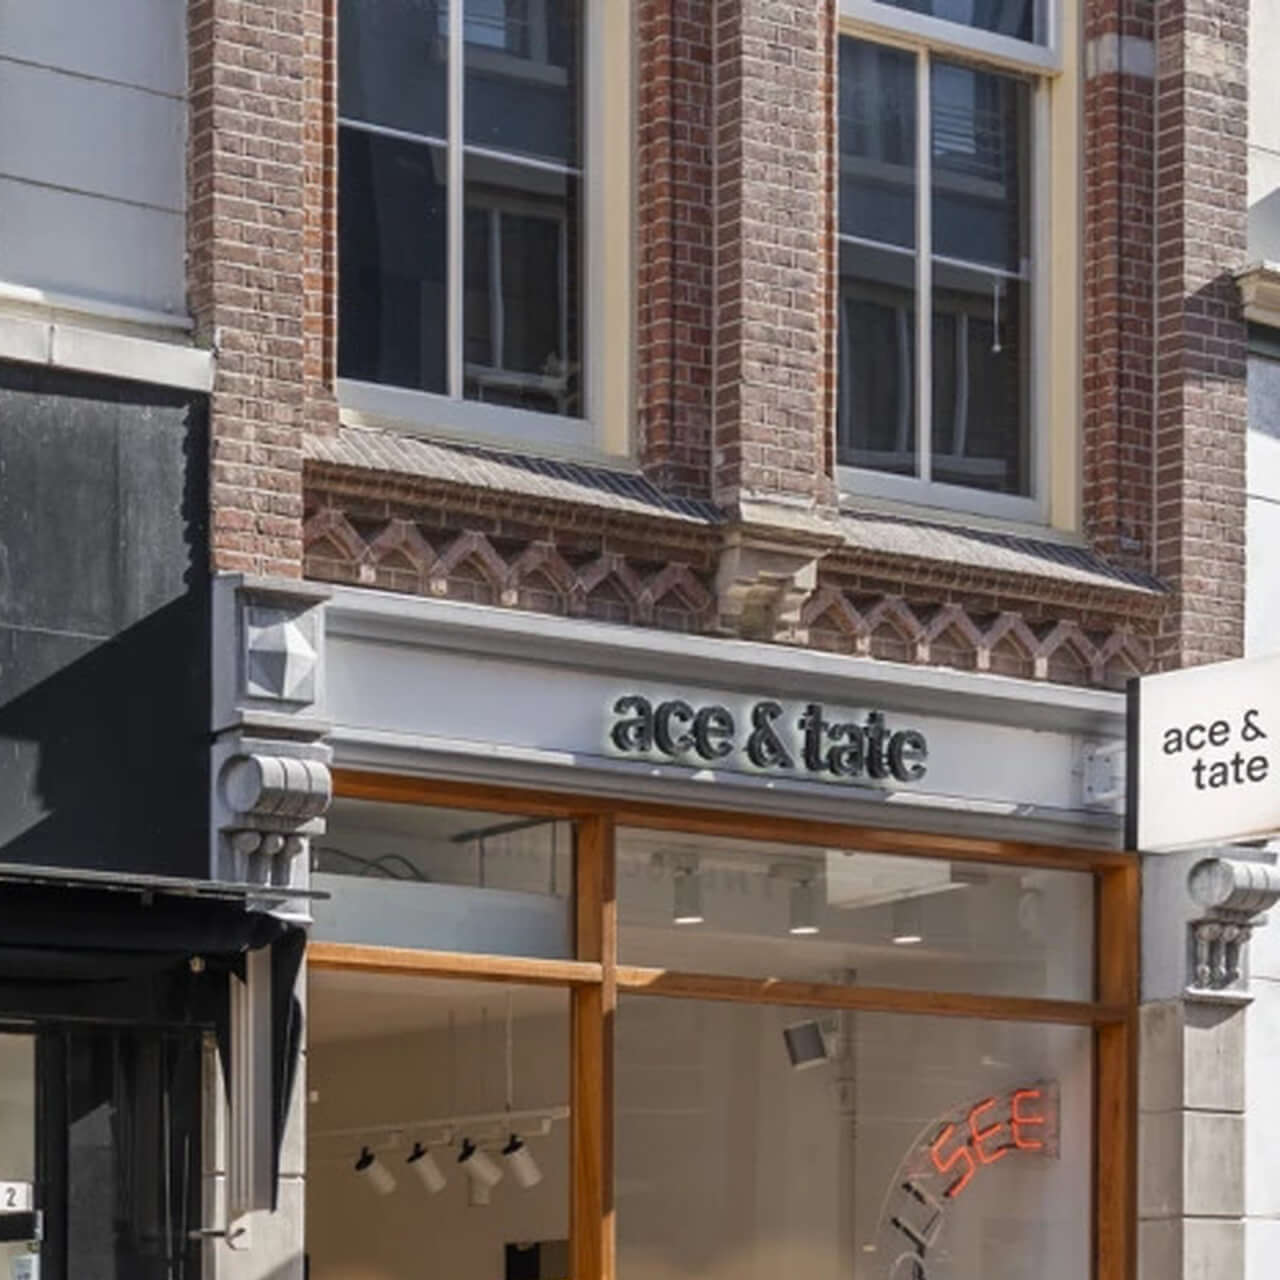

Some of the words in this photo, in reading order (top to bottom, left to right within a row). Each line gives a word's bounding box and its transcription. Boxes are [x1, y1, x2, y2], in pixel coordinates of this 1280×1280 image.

[610, 695, 736, 760] ace
[742, 701, 794, 768] &
[798, 703, 928, 783] tate
[1163, 719, 1231, 755] ace
[1241, 708, 1268, 742] &
[1192, 751, 1269, 790] tate
[6, 1186, 17, 1208] 2
